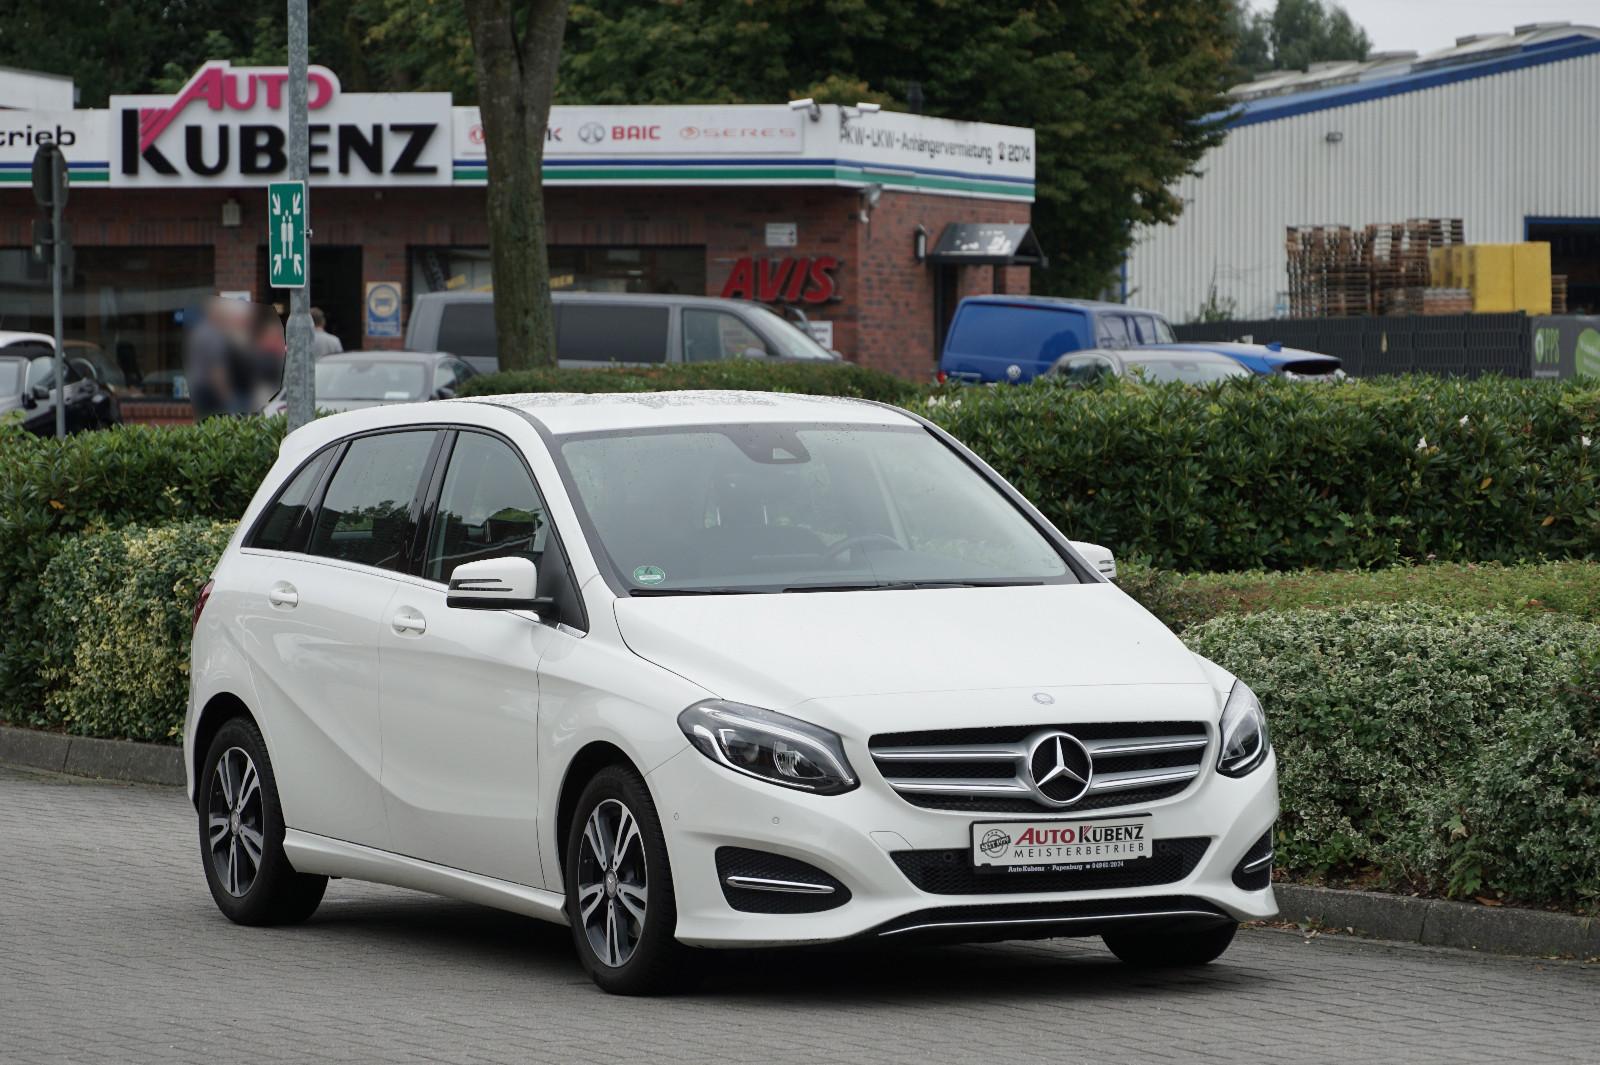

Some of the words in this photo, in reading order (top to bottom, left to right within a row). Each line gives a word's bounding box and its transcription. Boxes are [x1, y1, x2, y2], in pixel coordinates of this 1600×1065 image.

[181, 68, 333, 110] AUTO
[122, 108, 439, 176] KUBENZ
[612, 126, 661, 141] BAIC
[703, 127, 796, 139] SERES
[1008, 144, 1031, 162] 2074
[720, 256, 838, 303] AVIS
[1015, 828, 1075, 845] AUTO
[1079, 826, 1144, 843] KUBENZ
[1014, 843, 1144, 858] MEISTERBETRIEB
